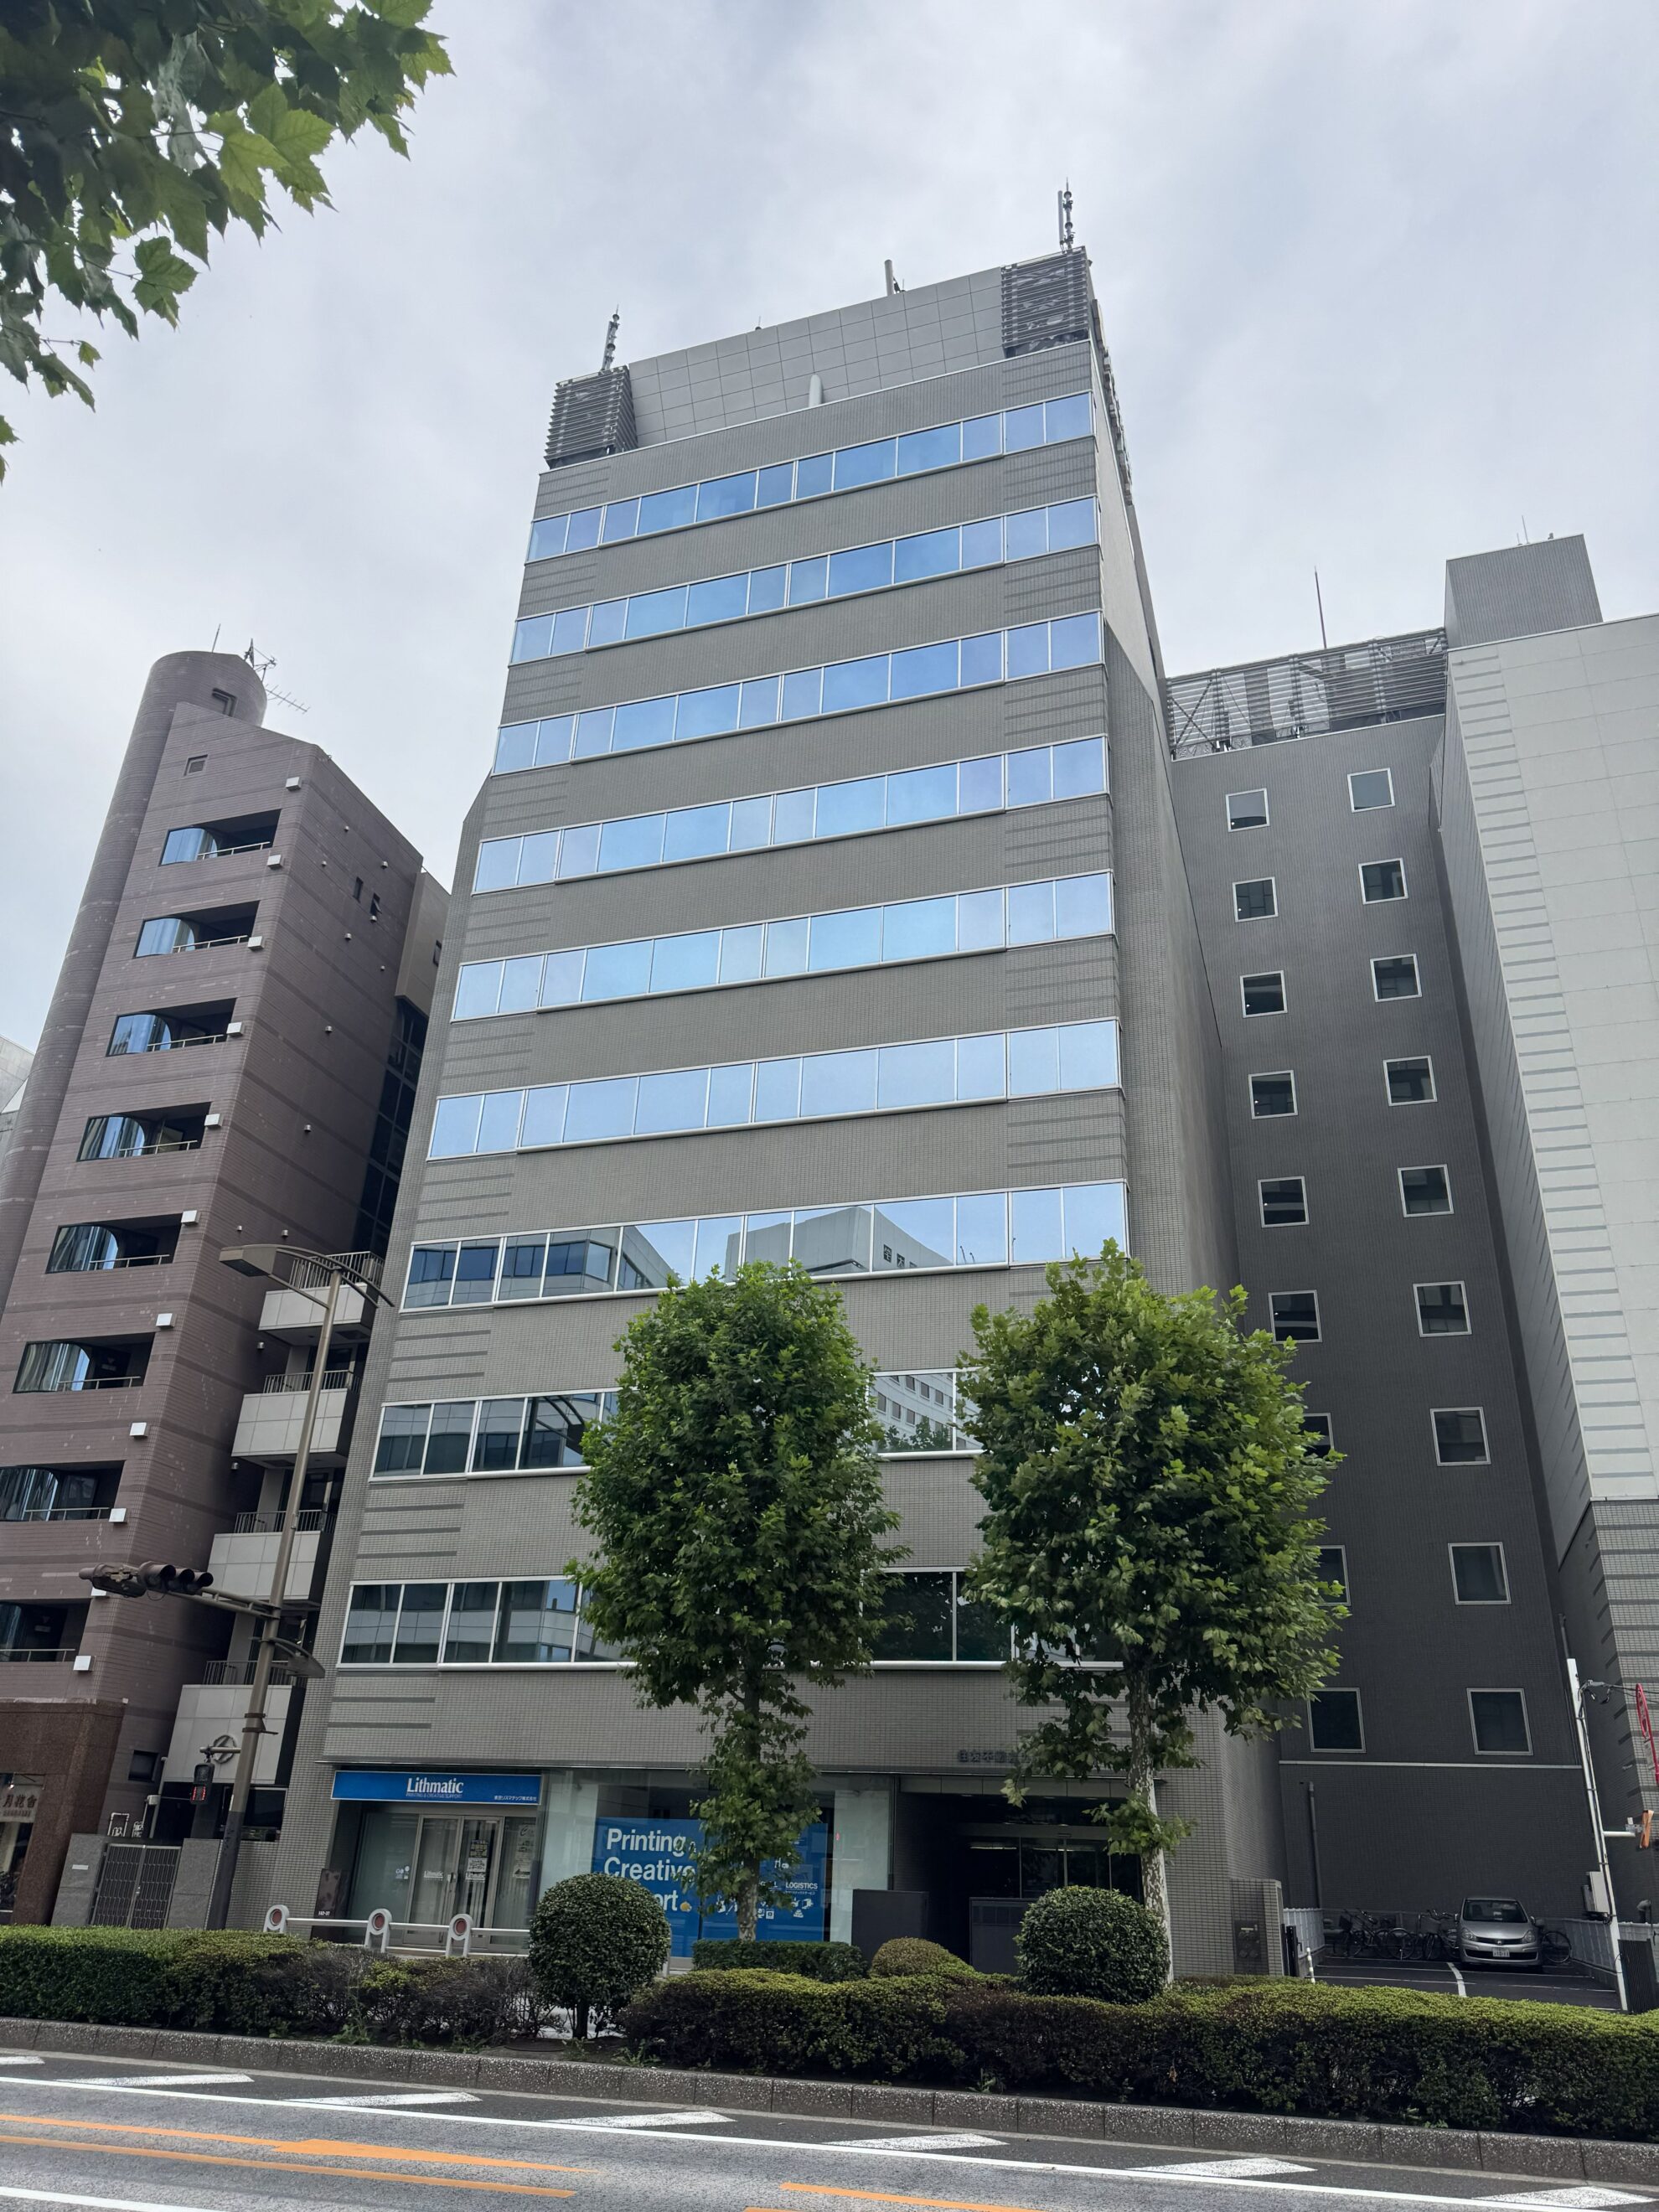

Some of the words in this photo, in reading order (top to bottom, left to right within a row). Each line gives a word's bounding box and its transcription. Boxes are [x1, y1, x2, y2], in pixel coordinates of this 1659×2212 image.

[406, 1777, 464, 1794] Lithmatic
[607, 1827, 686, 1858] Printing
[604, 1856, 696, 1882] Creative
